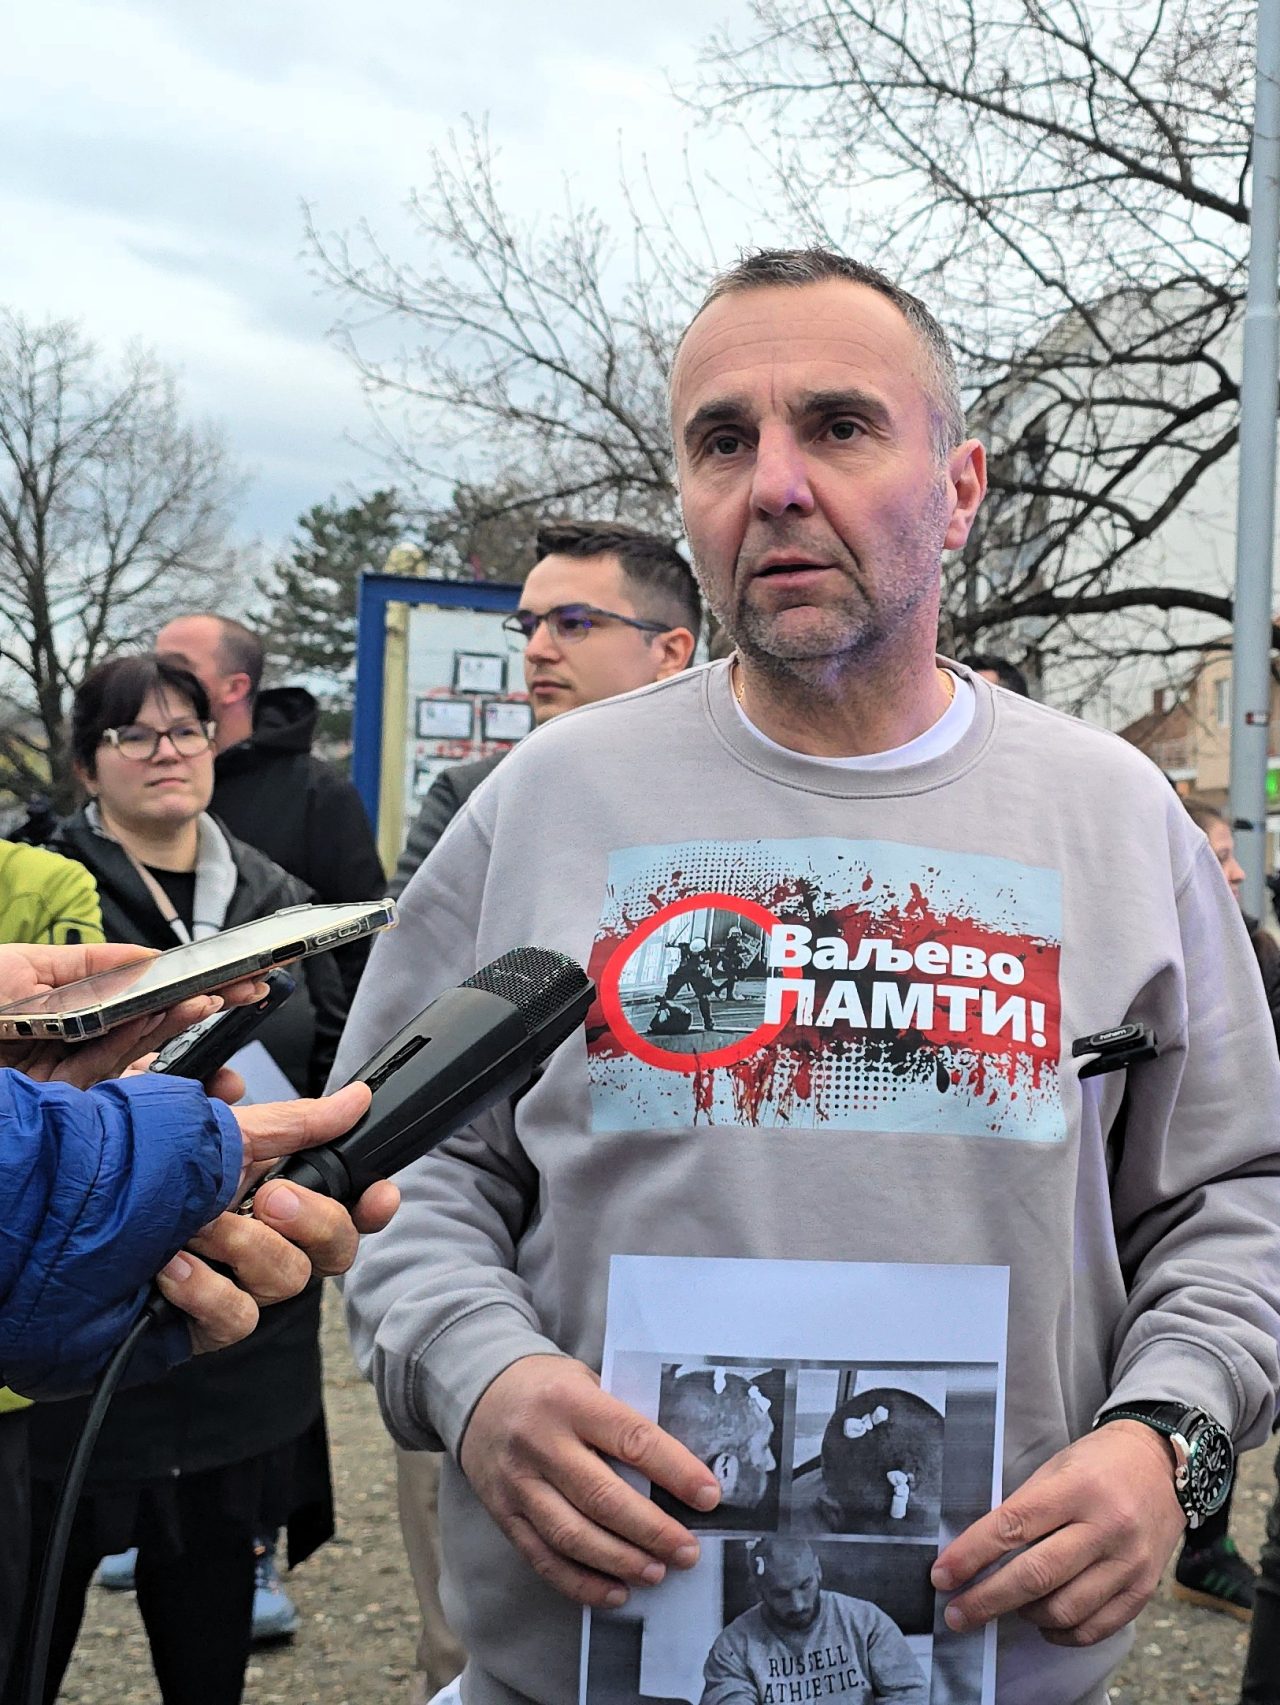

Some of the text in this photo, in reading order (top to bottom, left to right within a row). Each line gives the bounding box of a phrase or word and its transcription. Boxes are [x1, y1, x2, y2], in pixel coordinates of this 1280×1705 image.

[768, 924, 1025, 985] Ваљево
[764, 977, 1047, 1047] ПАМТИ!
[768, 1645, 848, 1677] RUSSELL
